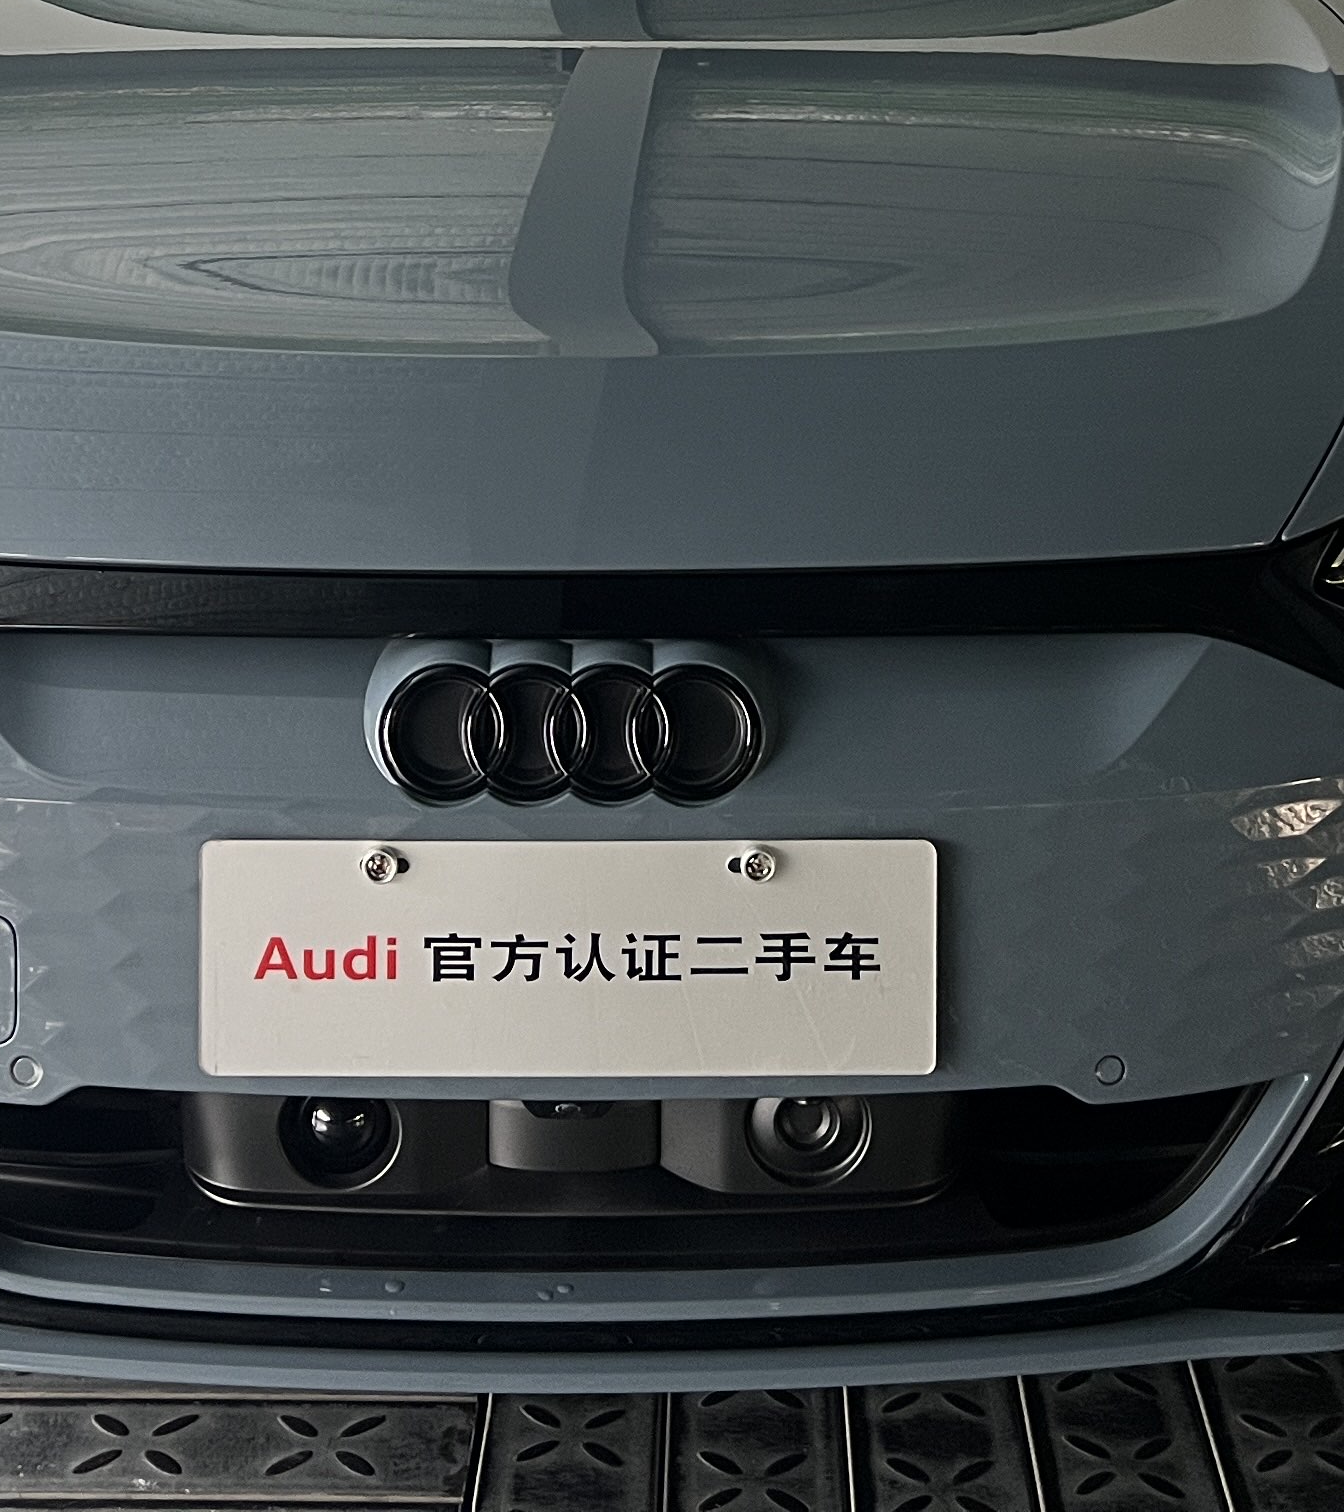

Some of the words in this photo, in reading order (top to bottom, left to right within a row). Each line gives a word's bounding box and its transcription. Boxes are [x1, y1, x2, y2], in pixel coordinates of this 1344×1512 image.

[254, 934, 400, 982] Audi
[423, 931, 882, 983] 官方认证二手车
